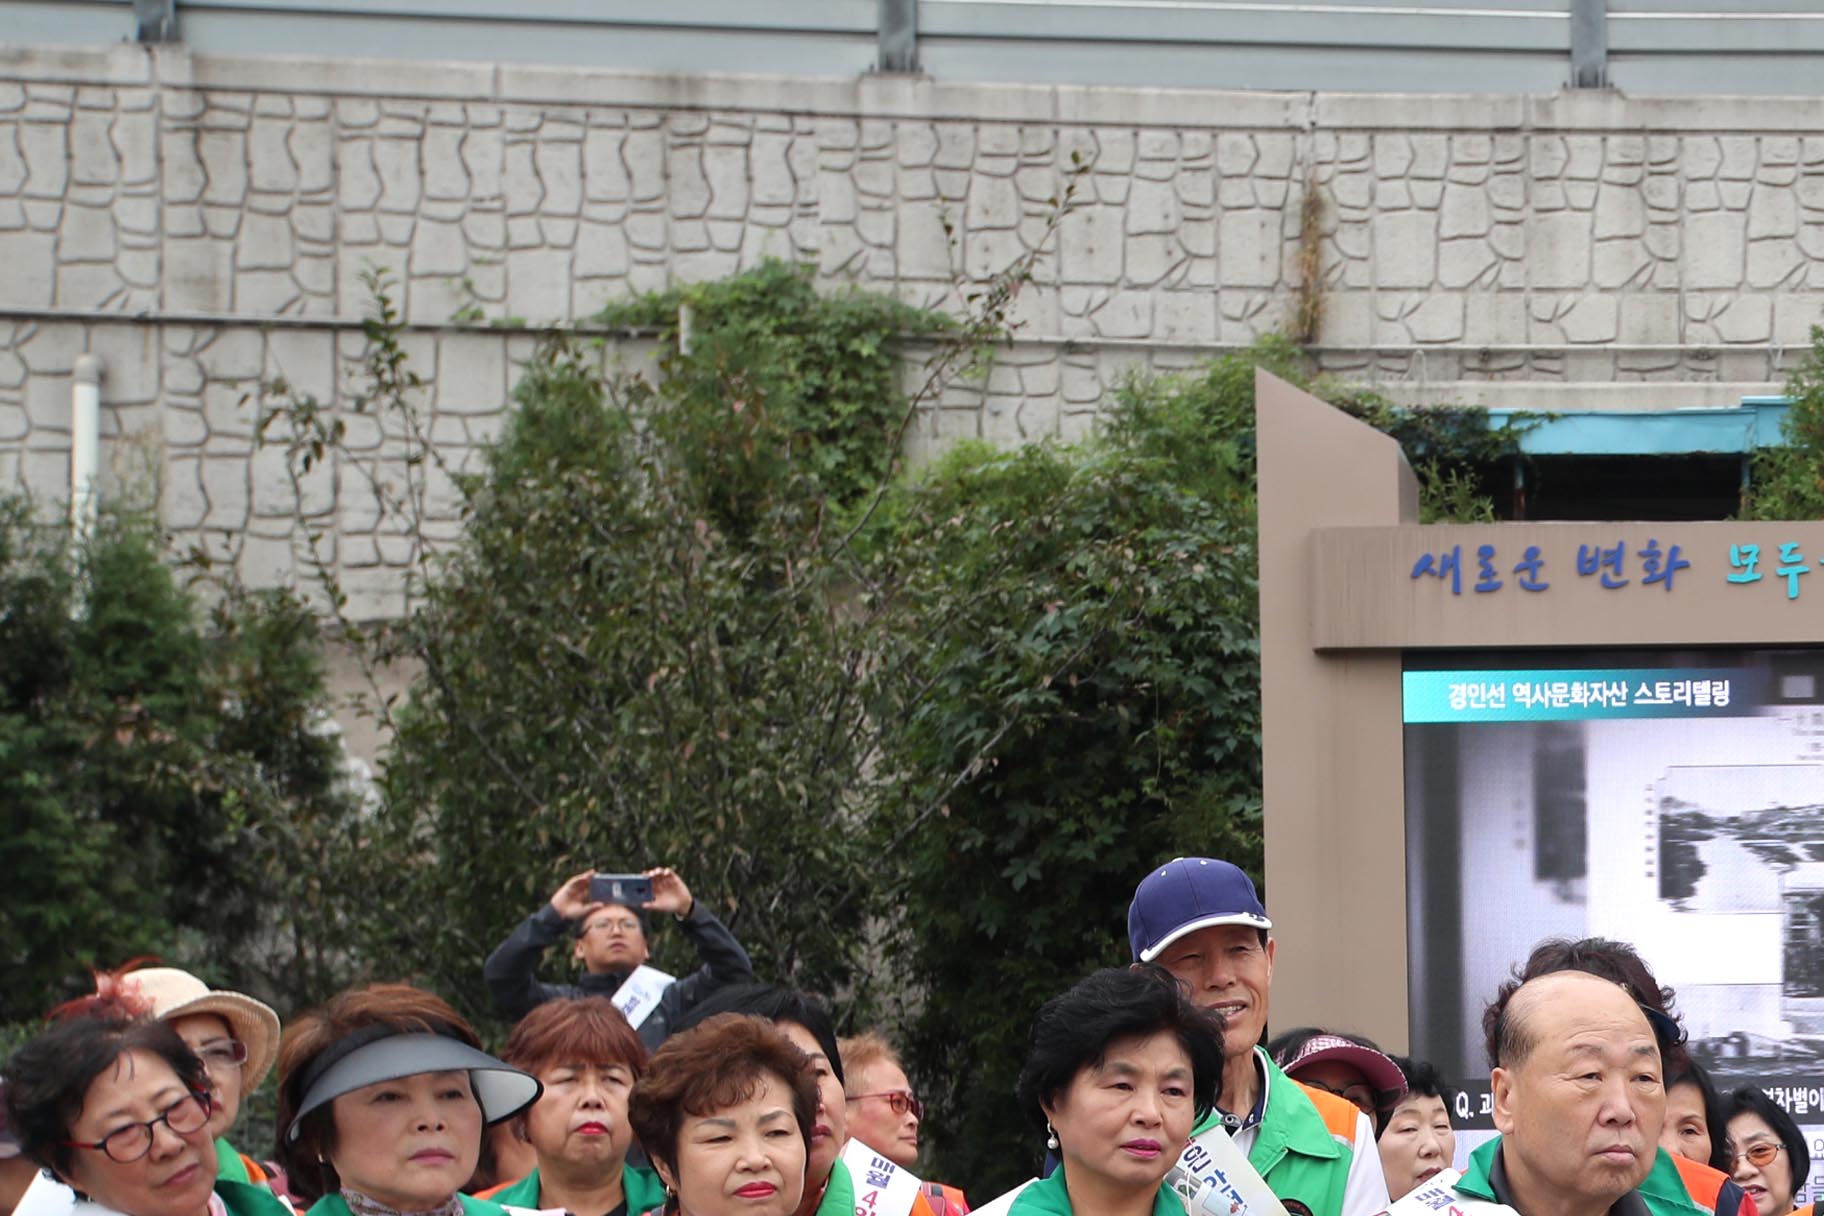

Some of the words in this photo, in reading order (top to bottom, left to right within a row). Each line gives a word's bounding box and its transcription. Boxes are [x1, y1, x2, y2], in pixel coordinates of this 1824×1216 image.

[1410, 544, 1549, 595] 새로운
[1576, 538, 1690, 591] 변화
[1448, 683, 1506, 710] 경인선
[1512, 681, 1629, 709] 역사문화자산
[1634, 680, 1731, 708] 스토리텔링
[1455, 1091, 1474, 1120] Q.
